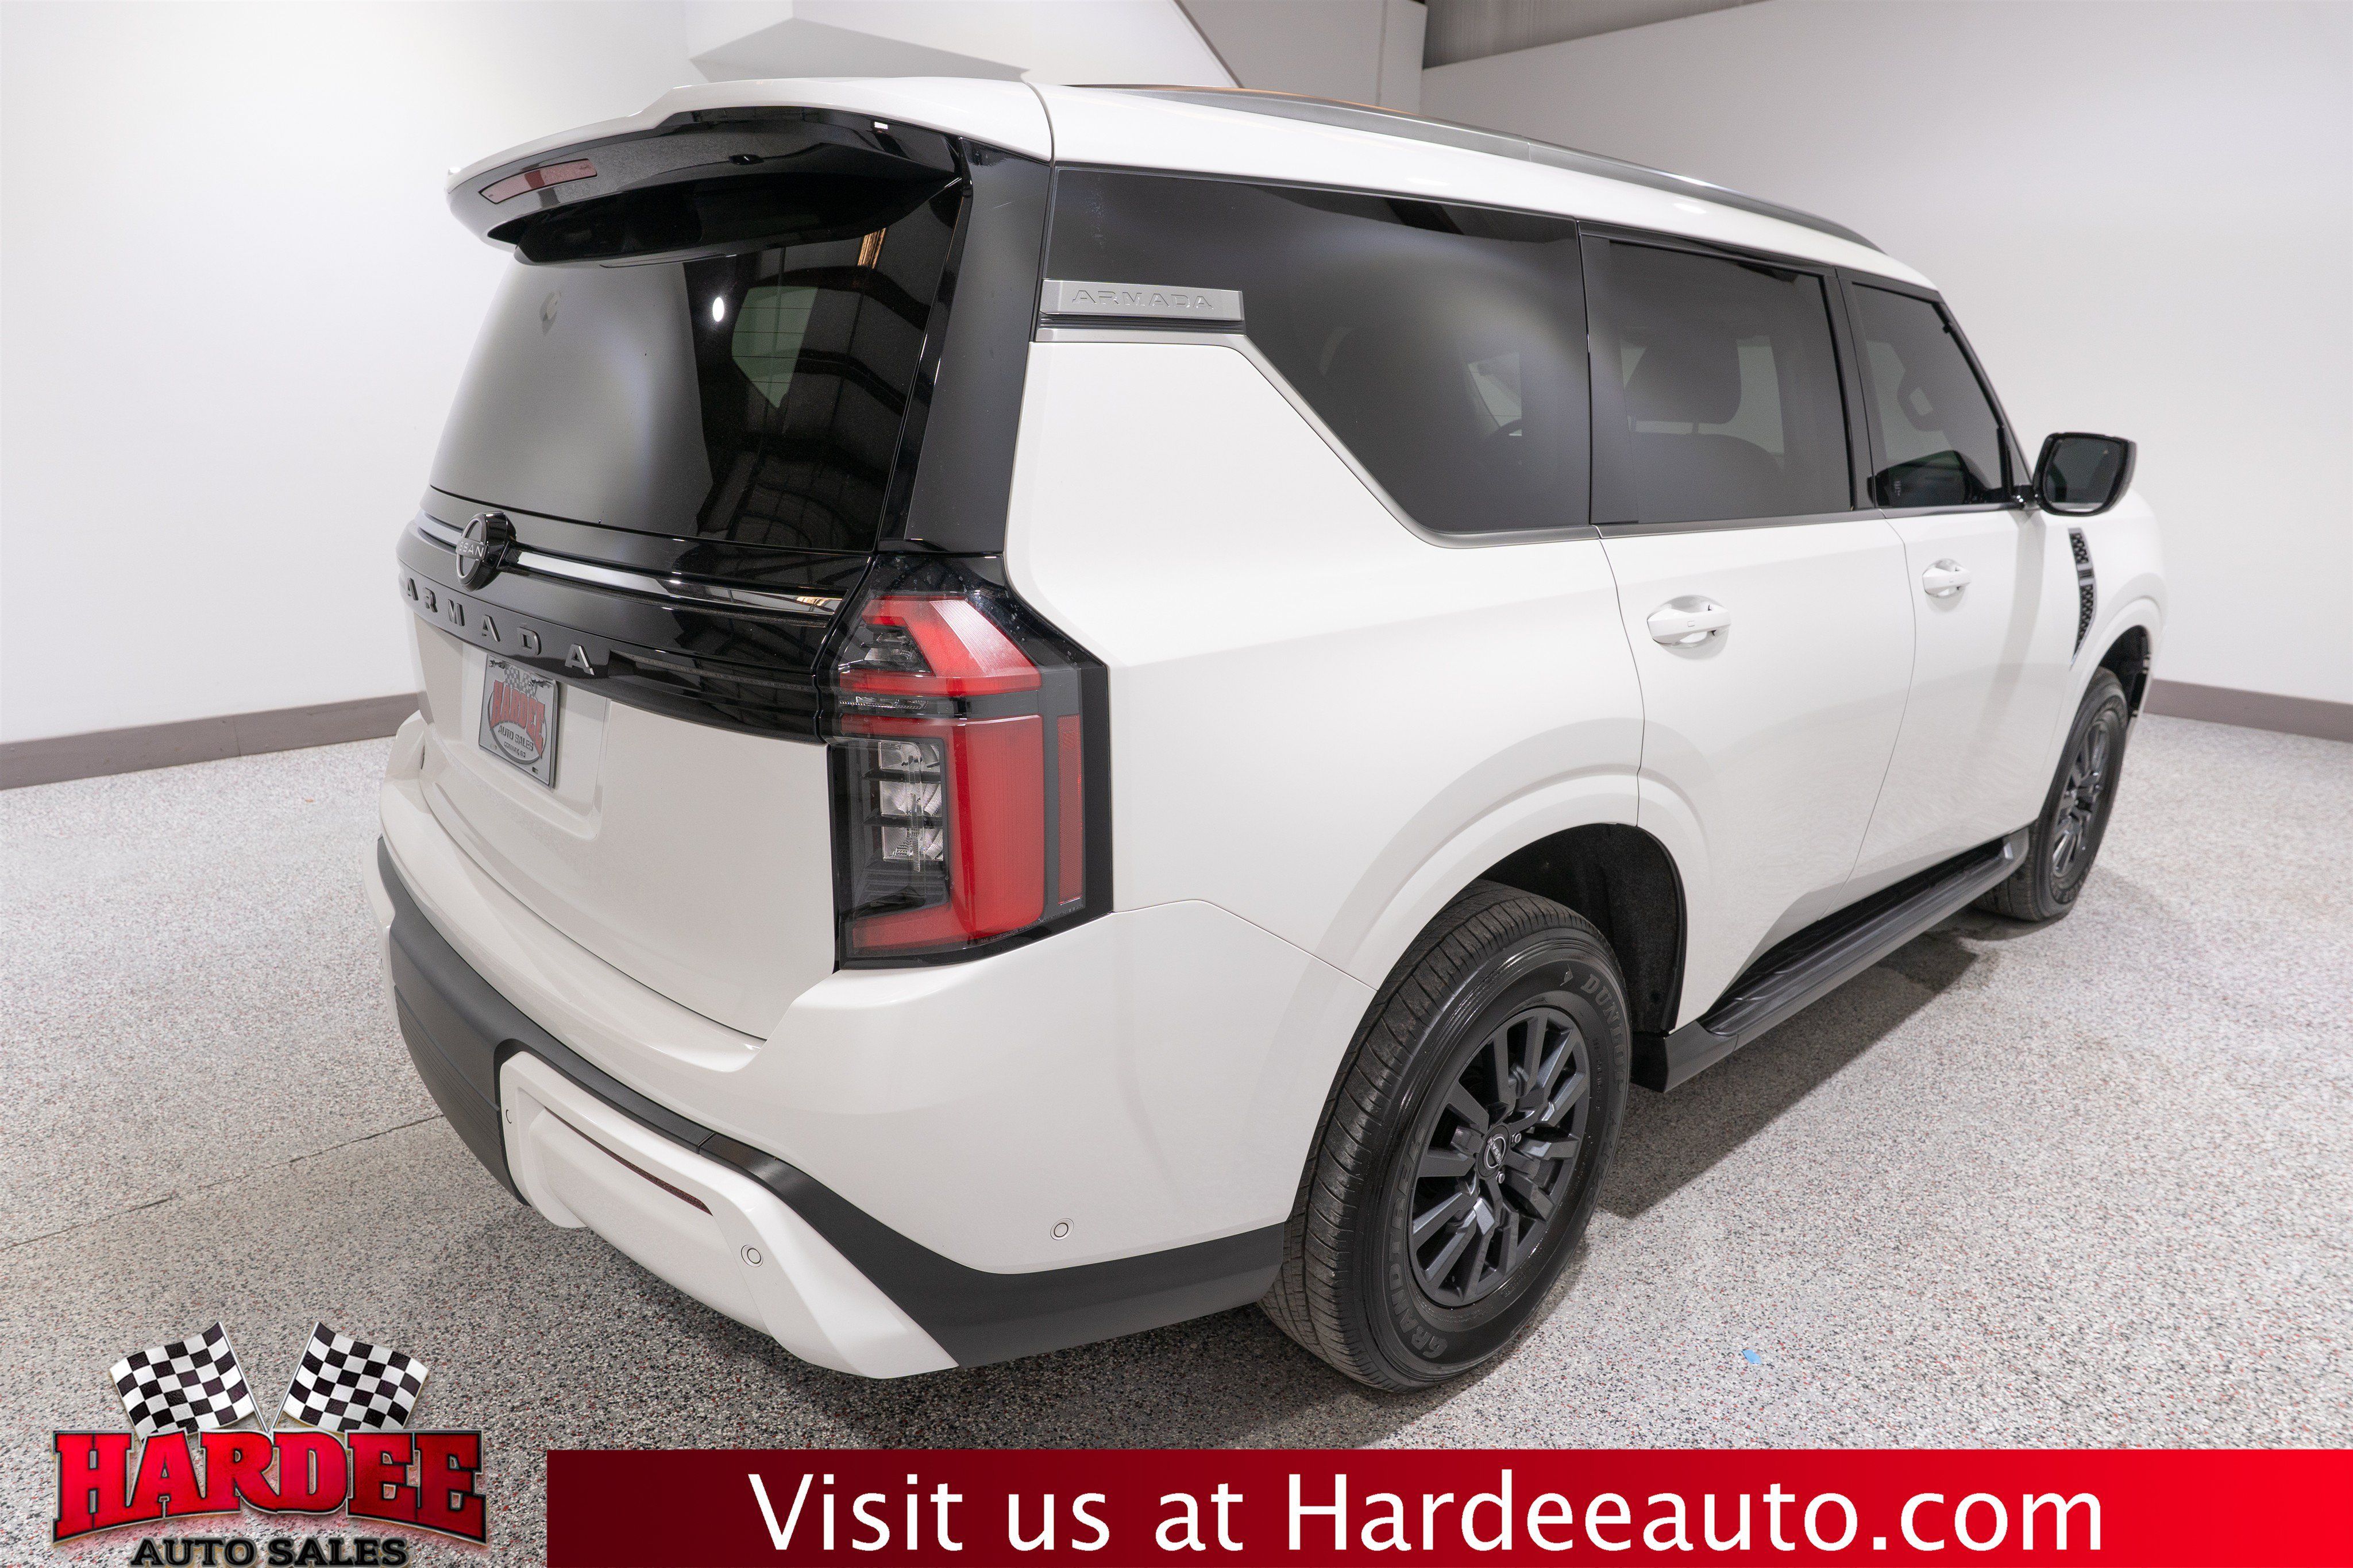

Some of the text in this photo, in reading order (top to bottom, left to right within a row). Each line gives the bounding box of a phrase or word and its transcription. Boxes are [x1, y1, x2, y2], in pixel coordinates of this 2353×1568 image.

[1071, 289, 1214, 310] ARMADA
[406, 577, 595, 676] ARMADA
[489, 679, 545, 759] HARDEE
[497, 725, 534, 752] AUTO SALES
[1580, 974, 1628, 1092] DUNLOP
[1388, 1128, 1448, 1359] GRANDTREK
